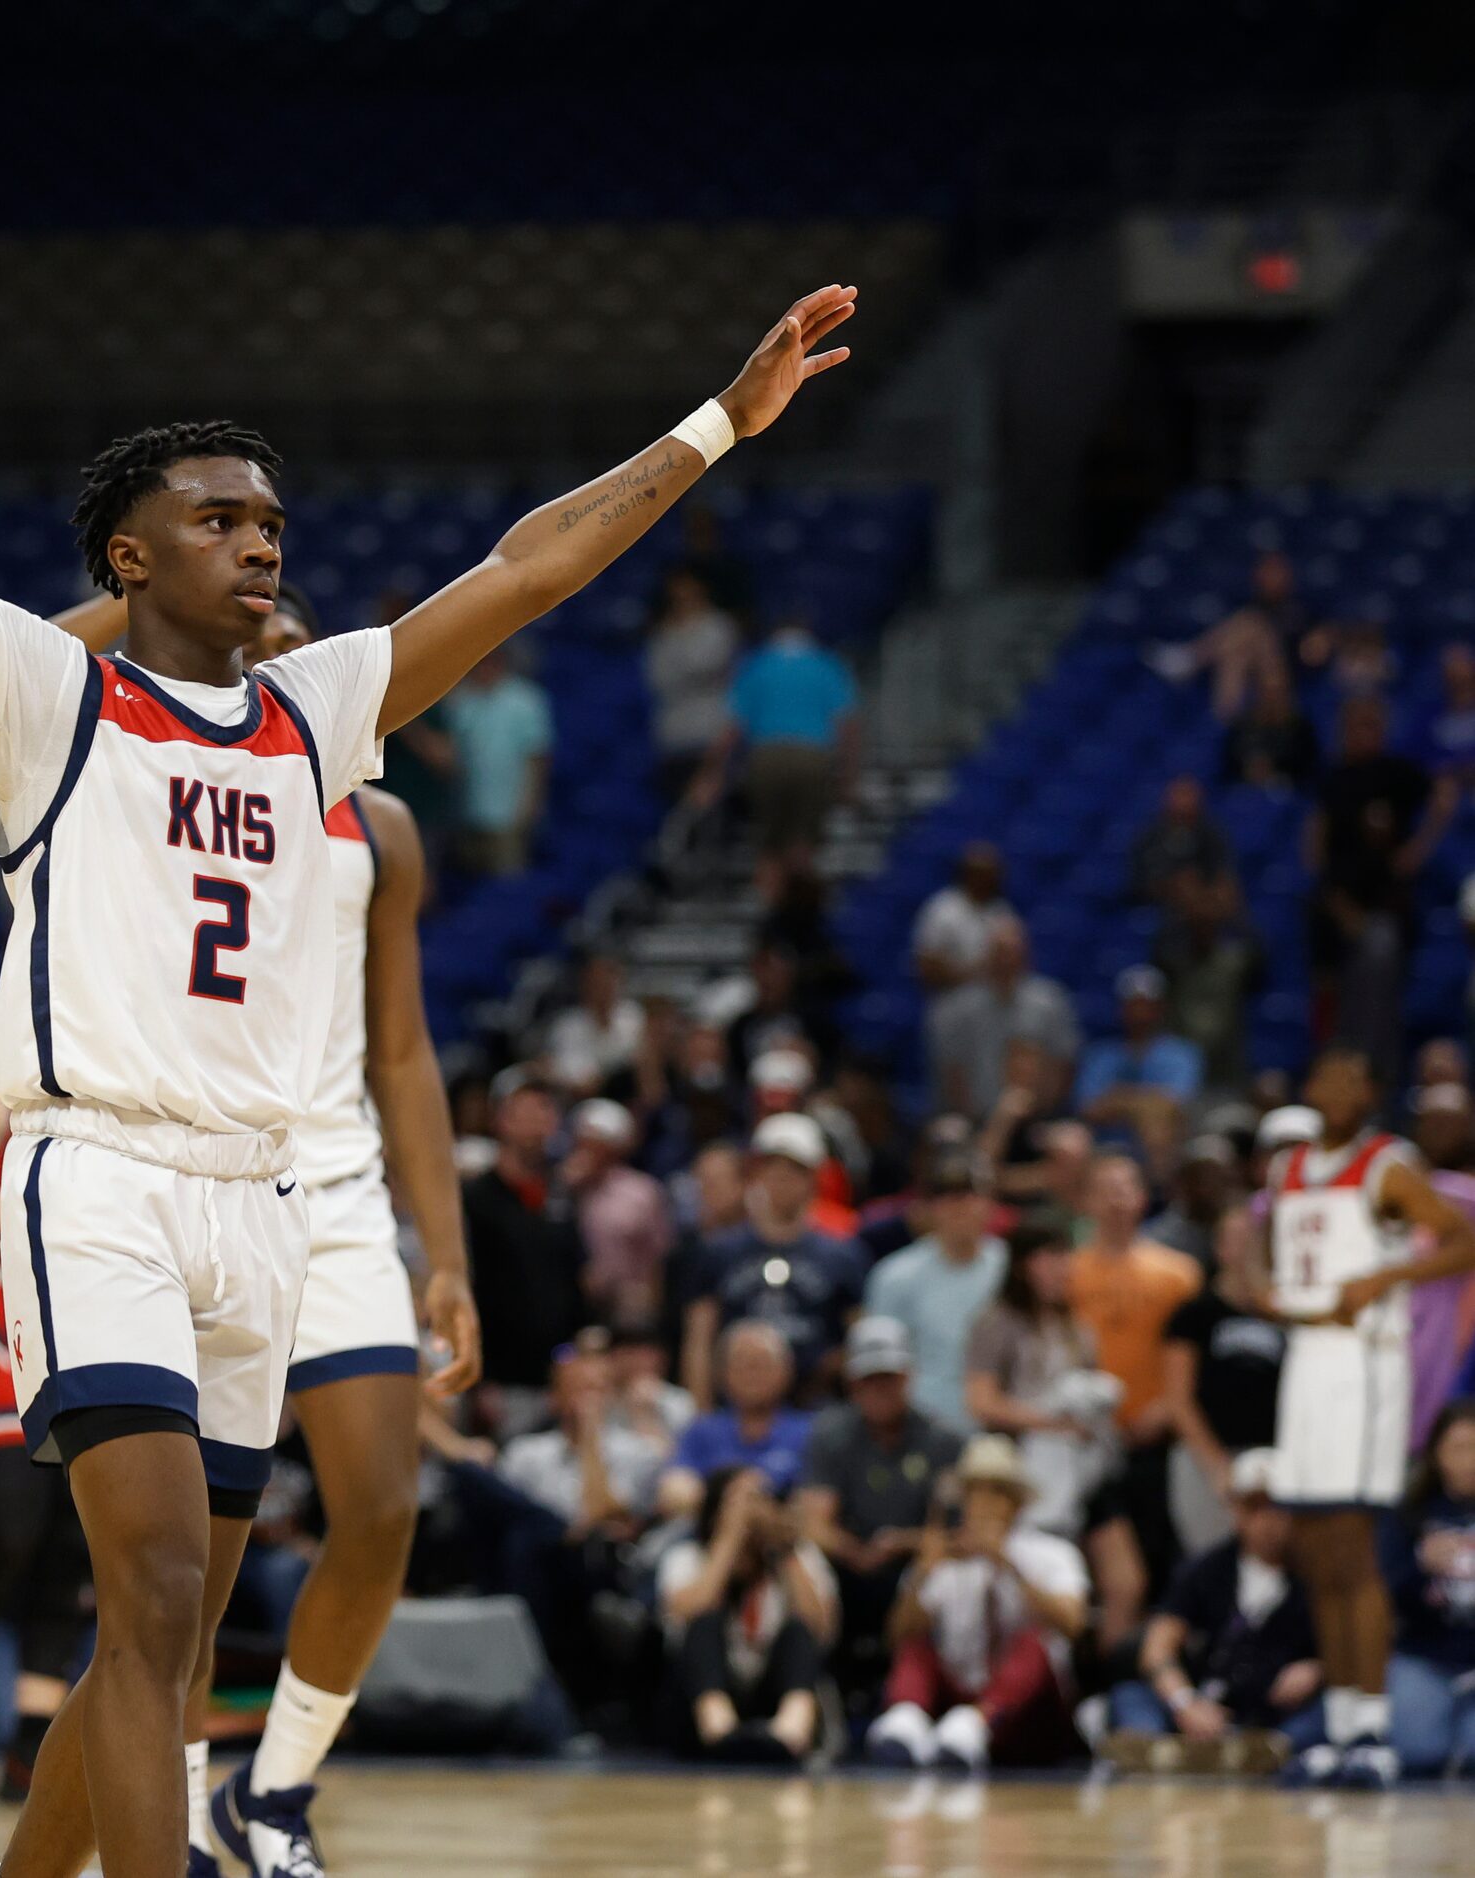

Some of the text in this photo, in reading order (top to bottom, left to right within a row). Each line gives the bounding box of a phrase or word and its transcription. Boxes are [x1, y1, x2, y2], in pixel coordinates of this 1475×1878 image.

[611, 453, 687, 497] Hedrick
[167, 776, 276, 866] KHS
[187, 873, 252, 1006] 2
